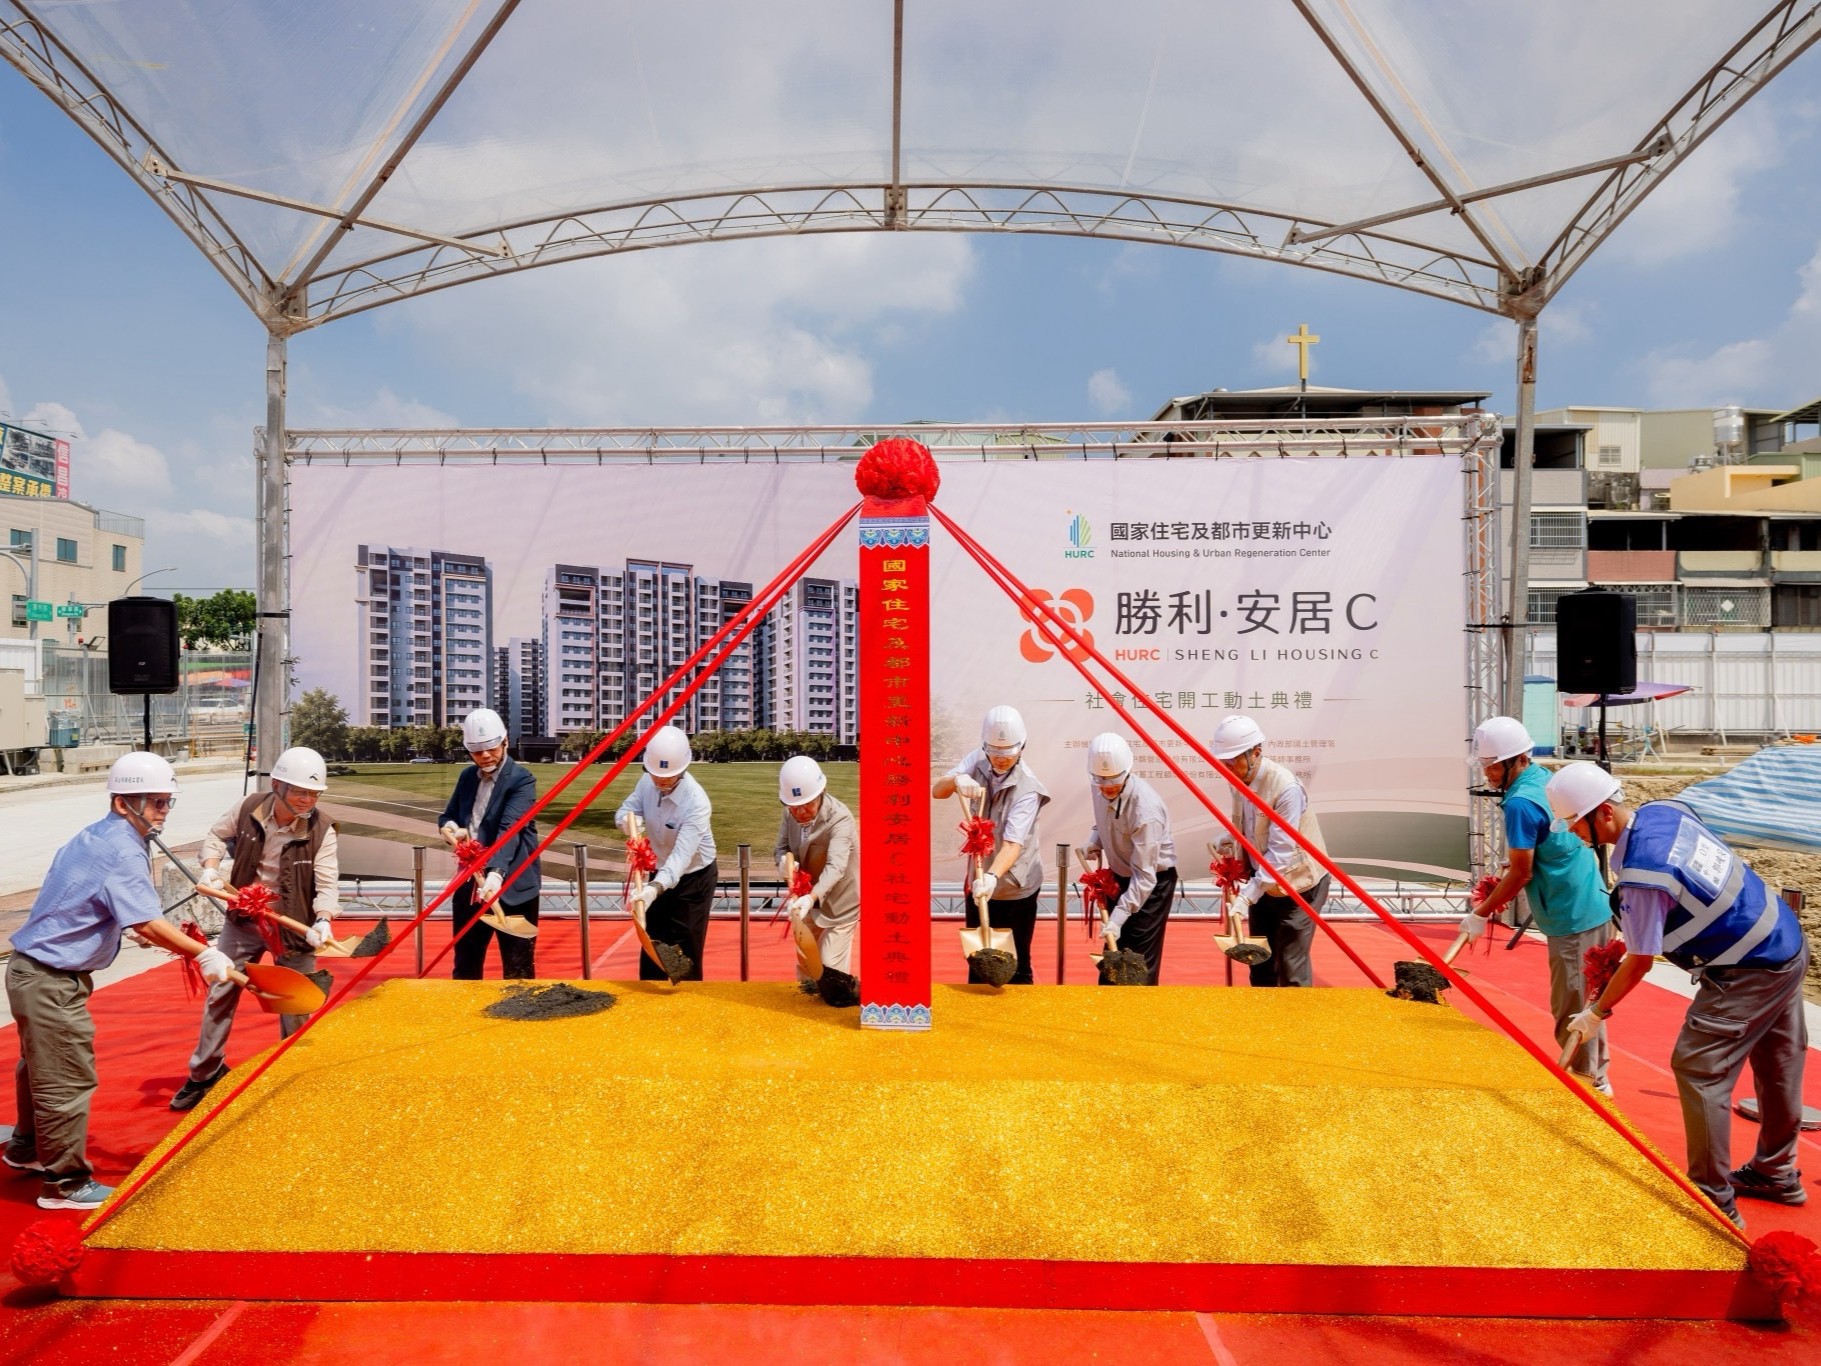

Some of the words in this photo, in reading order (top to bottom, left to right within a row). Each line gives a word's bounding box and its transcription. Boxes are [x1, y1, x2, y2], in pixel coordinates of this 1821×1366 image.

[1110, 521, 1332, 541] 國家住宅及都市更新中心
[1065, 550, 1095, 558] HURC
[1111, 549, 1150, 558] National
[1152, 549, 1190, 558] Housing
[1193, 549, 1200, 557] &
[1202, 549, 1232, 558] Urban
[1235, 548, 1297, 558] Regeneration
[1299, 548, 1331, 557] Center
[1115, 649, 1161, 661] HURC
[1175, 649, 1239, 660] SHENG
[1250, 649, 1266, 661] LI
[1277, 648, 1362, 660] HOUSING
[1369, 649, 1379, 659] C
[1085, 691, 1313, 710] 社會住宅開工動土典禮
